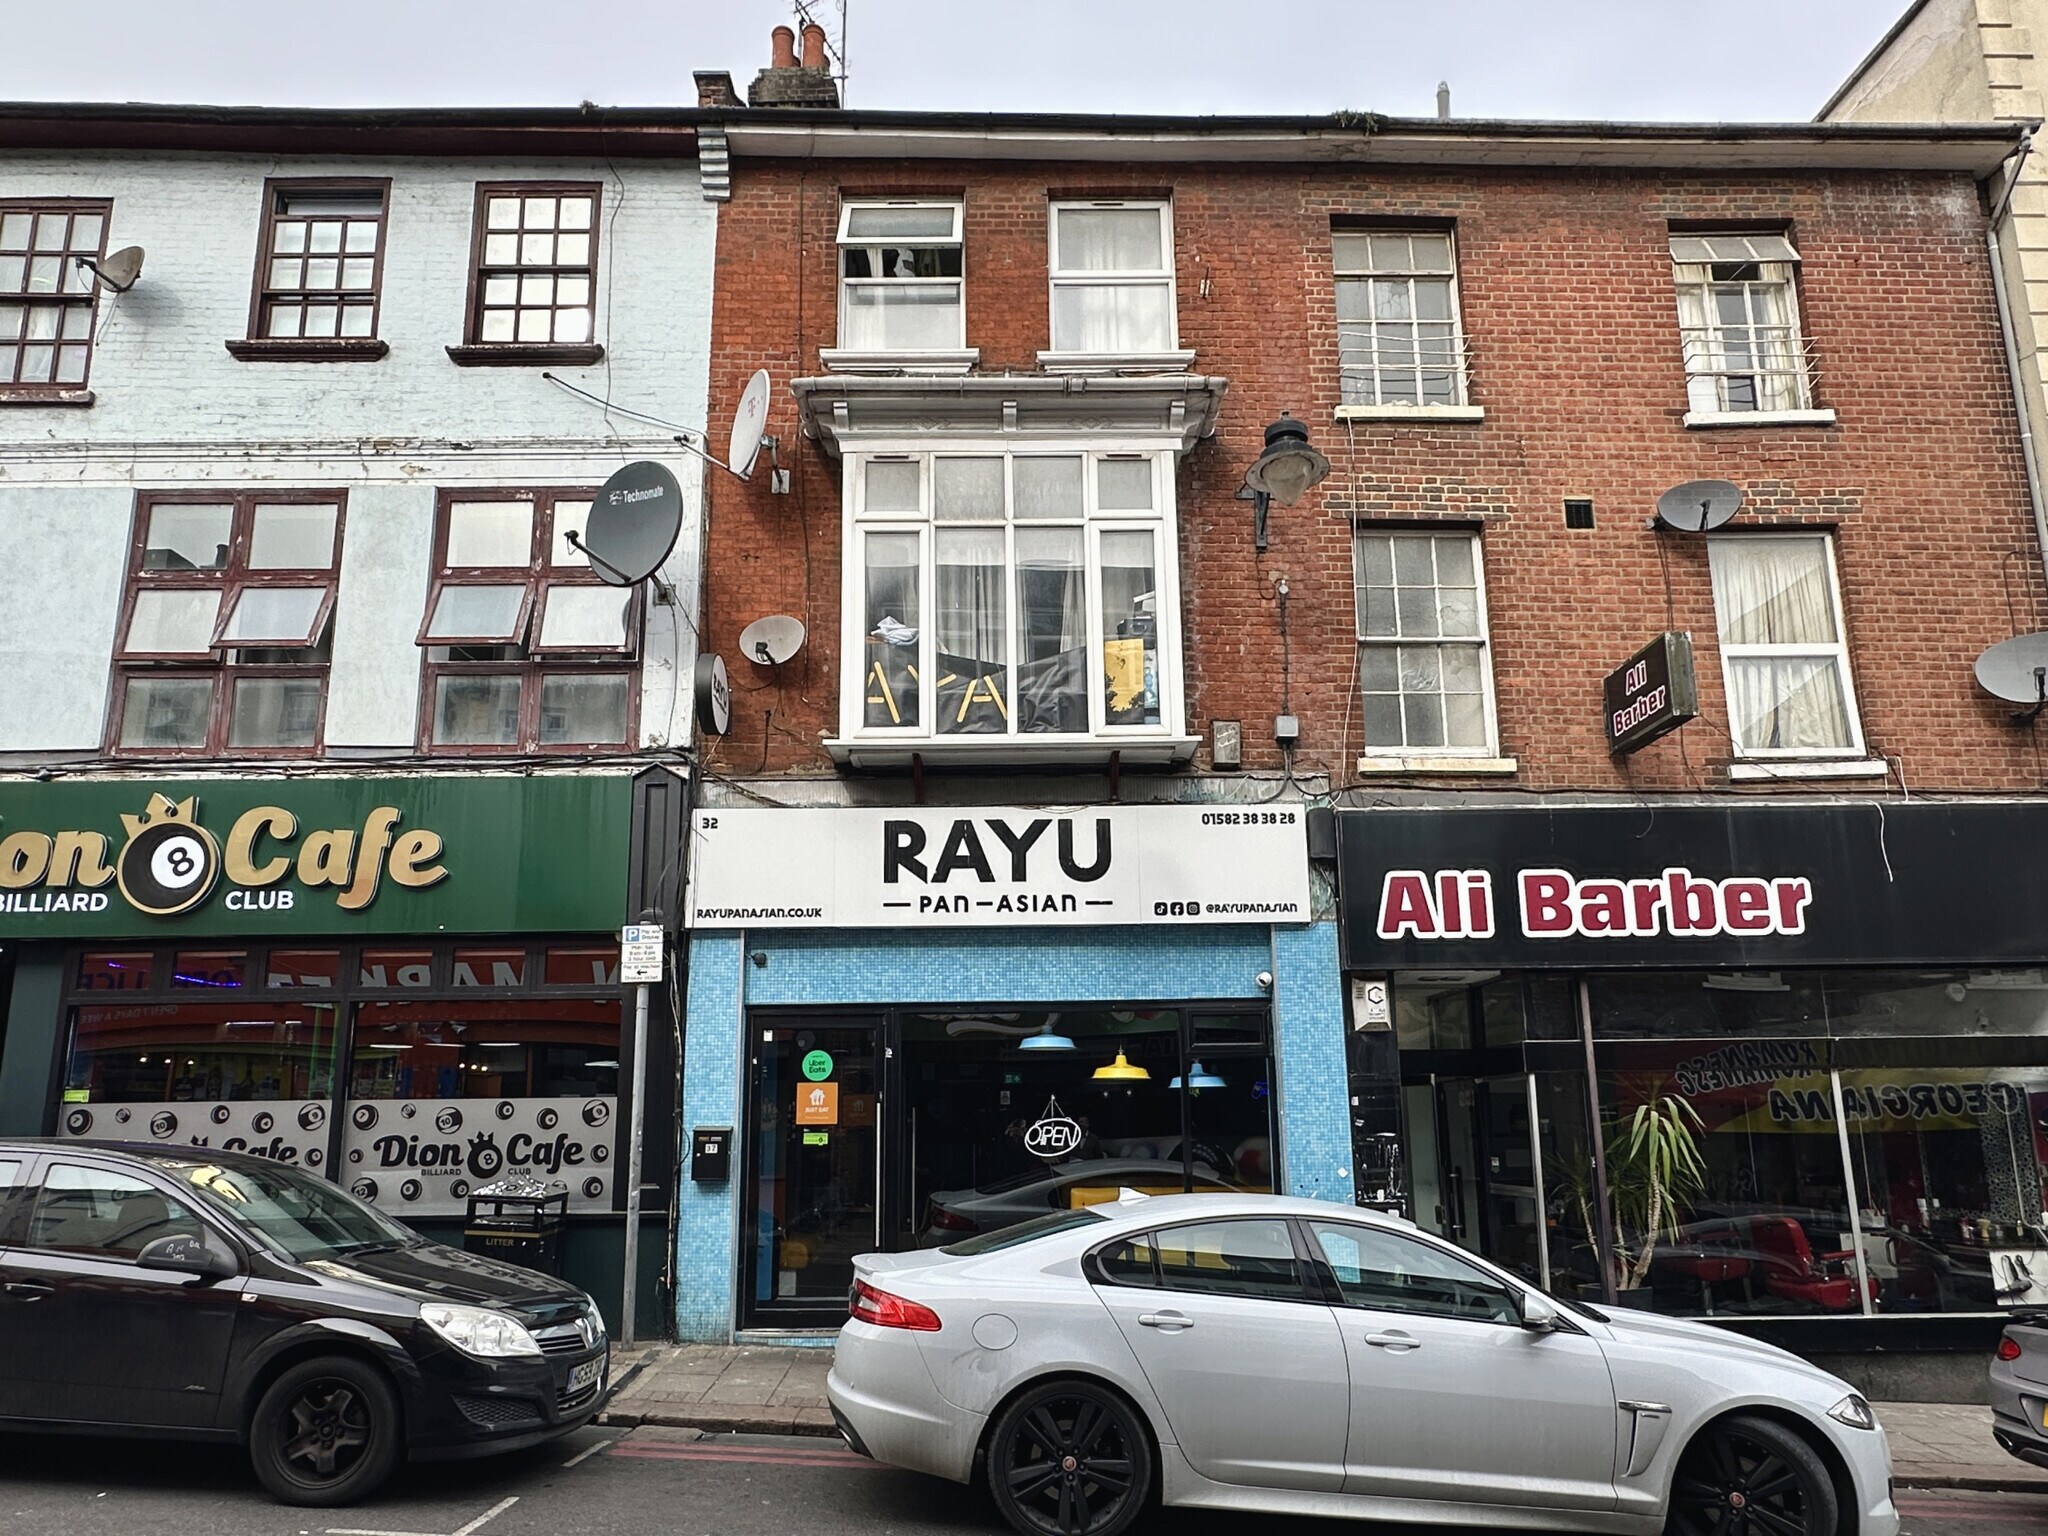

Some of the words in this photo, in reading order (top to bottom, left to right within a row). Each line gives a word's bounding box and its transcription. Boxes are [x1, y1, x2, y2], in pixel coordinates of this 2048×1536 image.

[623, 485, 664, 503] Technomate
[1625, 660, 1648, 696] Ali
[1612, 685, 1666, 737] Barber
[702, 817, 719, 829] 32
[1201, 813, 1240, 825] 01582
[1243, 813, 1259, 825] 38
[1261, 813, 1277, 824] 38
[1279, 813, 1296, 824] 28
[0, 830, 117, 889] on
[224, 805, 449, 909] Cafe
[883, 818, 1112, 884] RAYU
[225, 891, 295, 910] CLUB
[996, 894, 1077, 913] ASIAN
[1205, 903, 1298, 914] @RAYUPANASIAN
[1376, 869, 1496, 939] Ali
[1516, 867, 1813, 938] Barber
[696, 907, 823, 919] RAYUPANASIAN.CO.UK
[1027, 1125, 1079, 1146] OPEN
[373, 1135, 464, 1167] Dion
[506, 1133, 585, 1174] Cafe
[421, 1168, 462, 1176] BILLIARD
[508, 1167, 532, 1176] CLUB
[486, 1238, 514, 1246] LITTER
